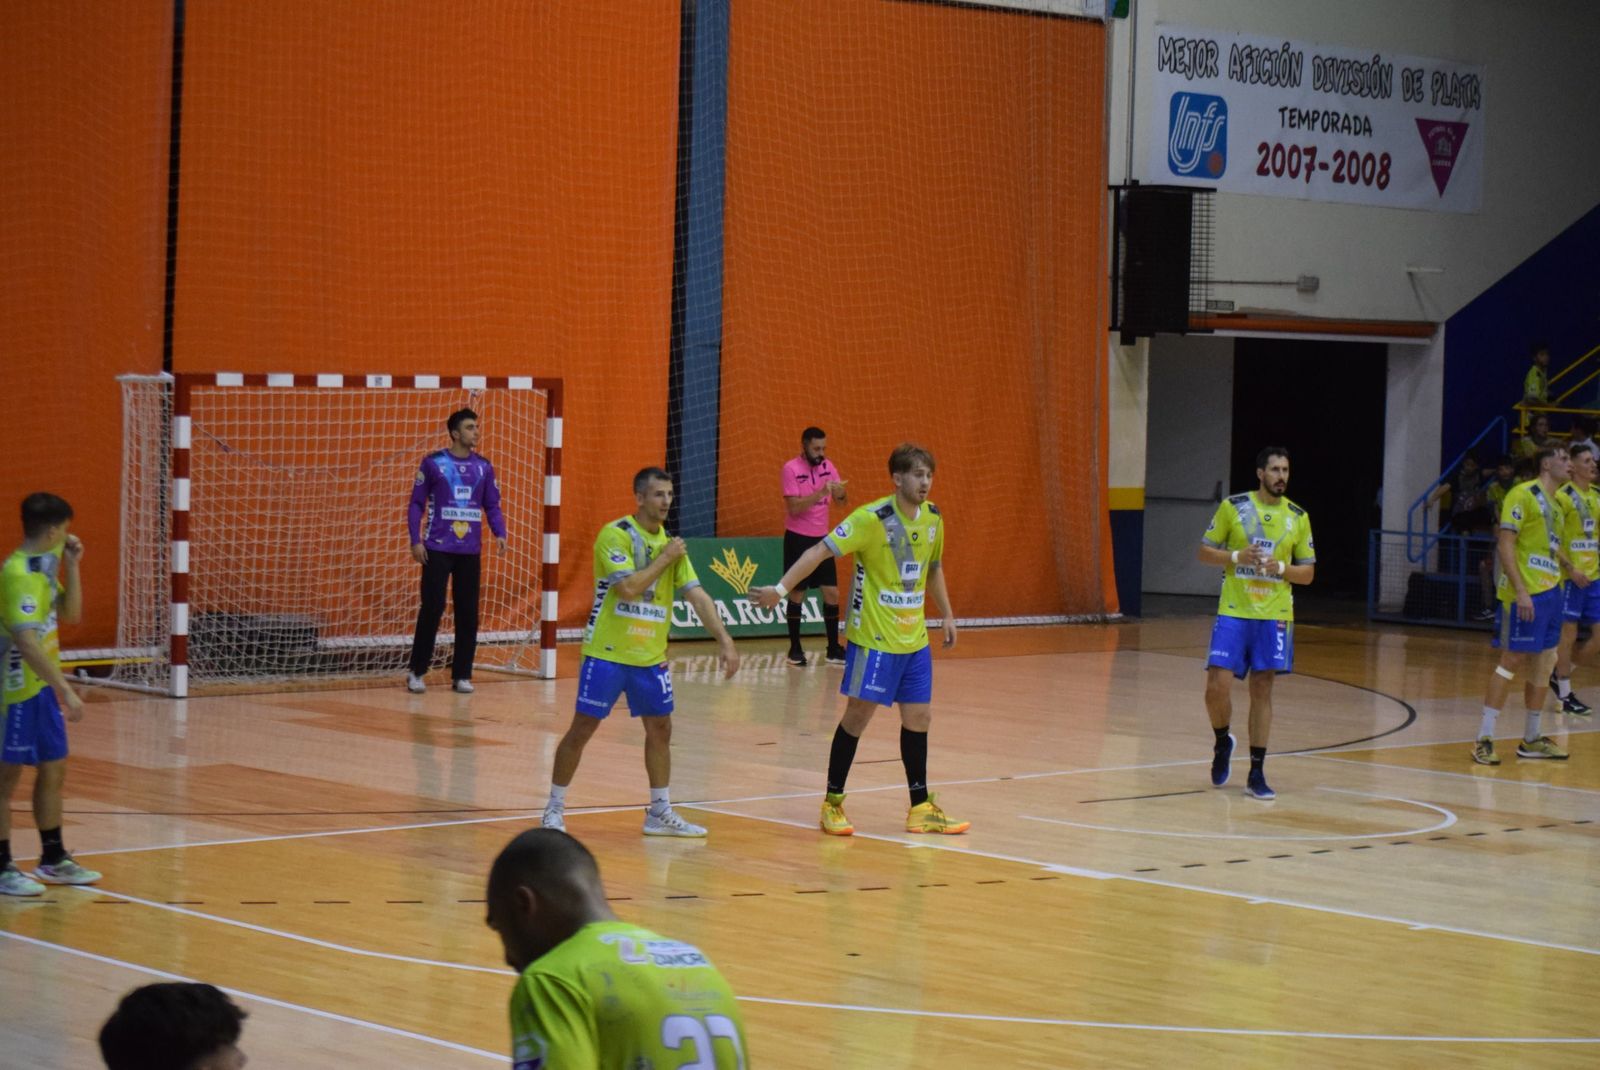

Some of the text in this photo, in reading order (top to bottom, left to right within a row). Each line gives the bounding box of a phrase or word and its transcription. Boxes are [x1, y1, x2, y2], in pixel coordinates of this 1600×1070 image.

[1158, 35, 1481, 111] MEJOR AFICIÓN DIVISIÓN DE PLATA
[1278, 106, 1373, 137] TEMPORADA
[1256, 141, 1392, 191] 2007-2008
[671, 600, 739, 627] CAA
[1276, 631, 1284, 652] 5
[657, 671, 673, 694] 19
